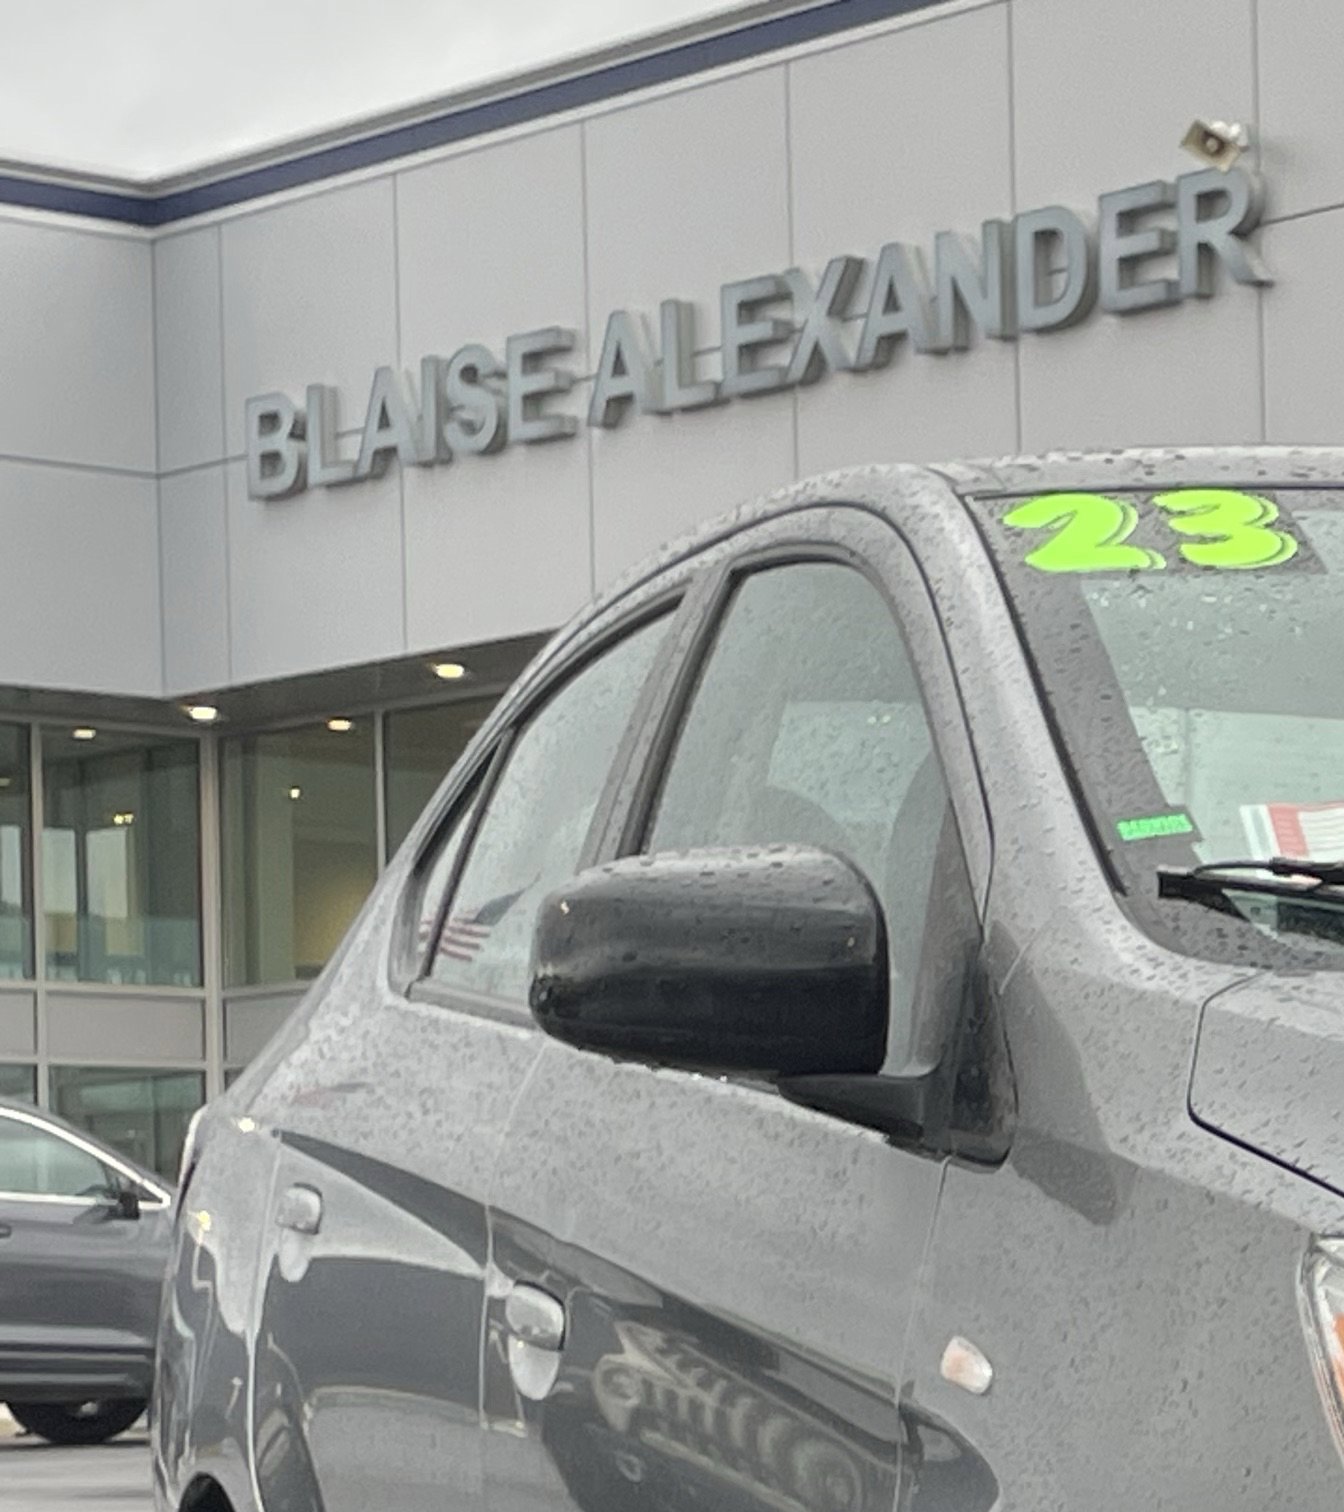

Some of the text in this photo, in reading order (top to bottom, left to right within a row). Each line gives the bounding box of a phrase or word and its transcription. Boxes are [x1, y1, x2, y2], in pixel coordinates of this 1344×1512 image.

[245, 165, 1275, 502] BLAISE ALEXANDER
[1002, 489, 1298, 572] 23
